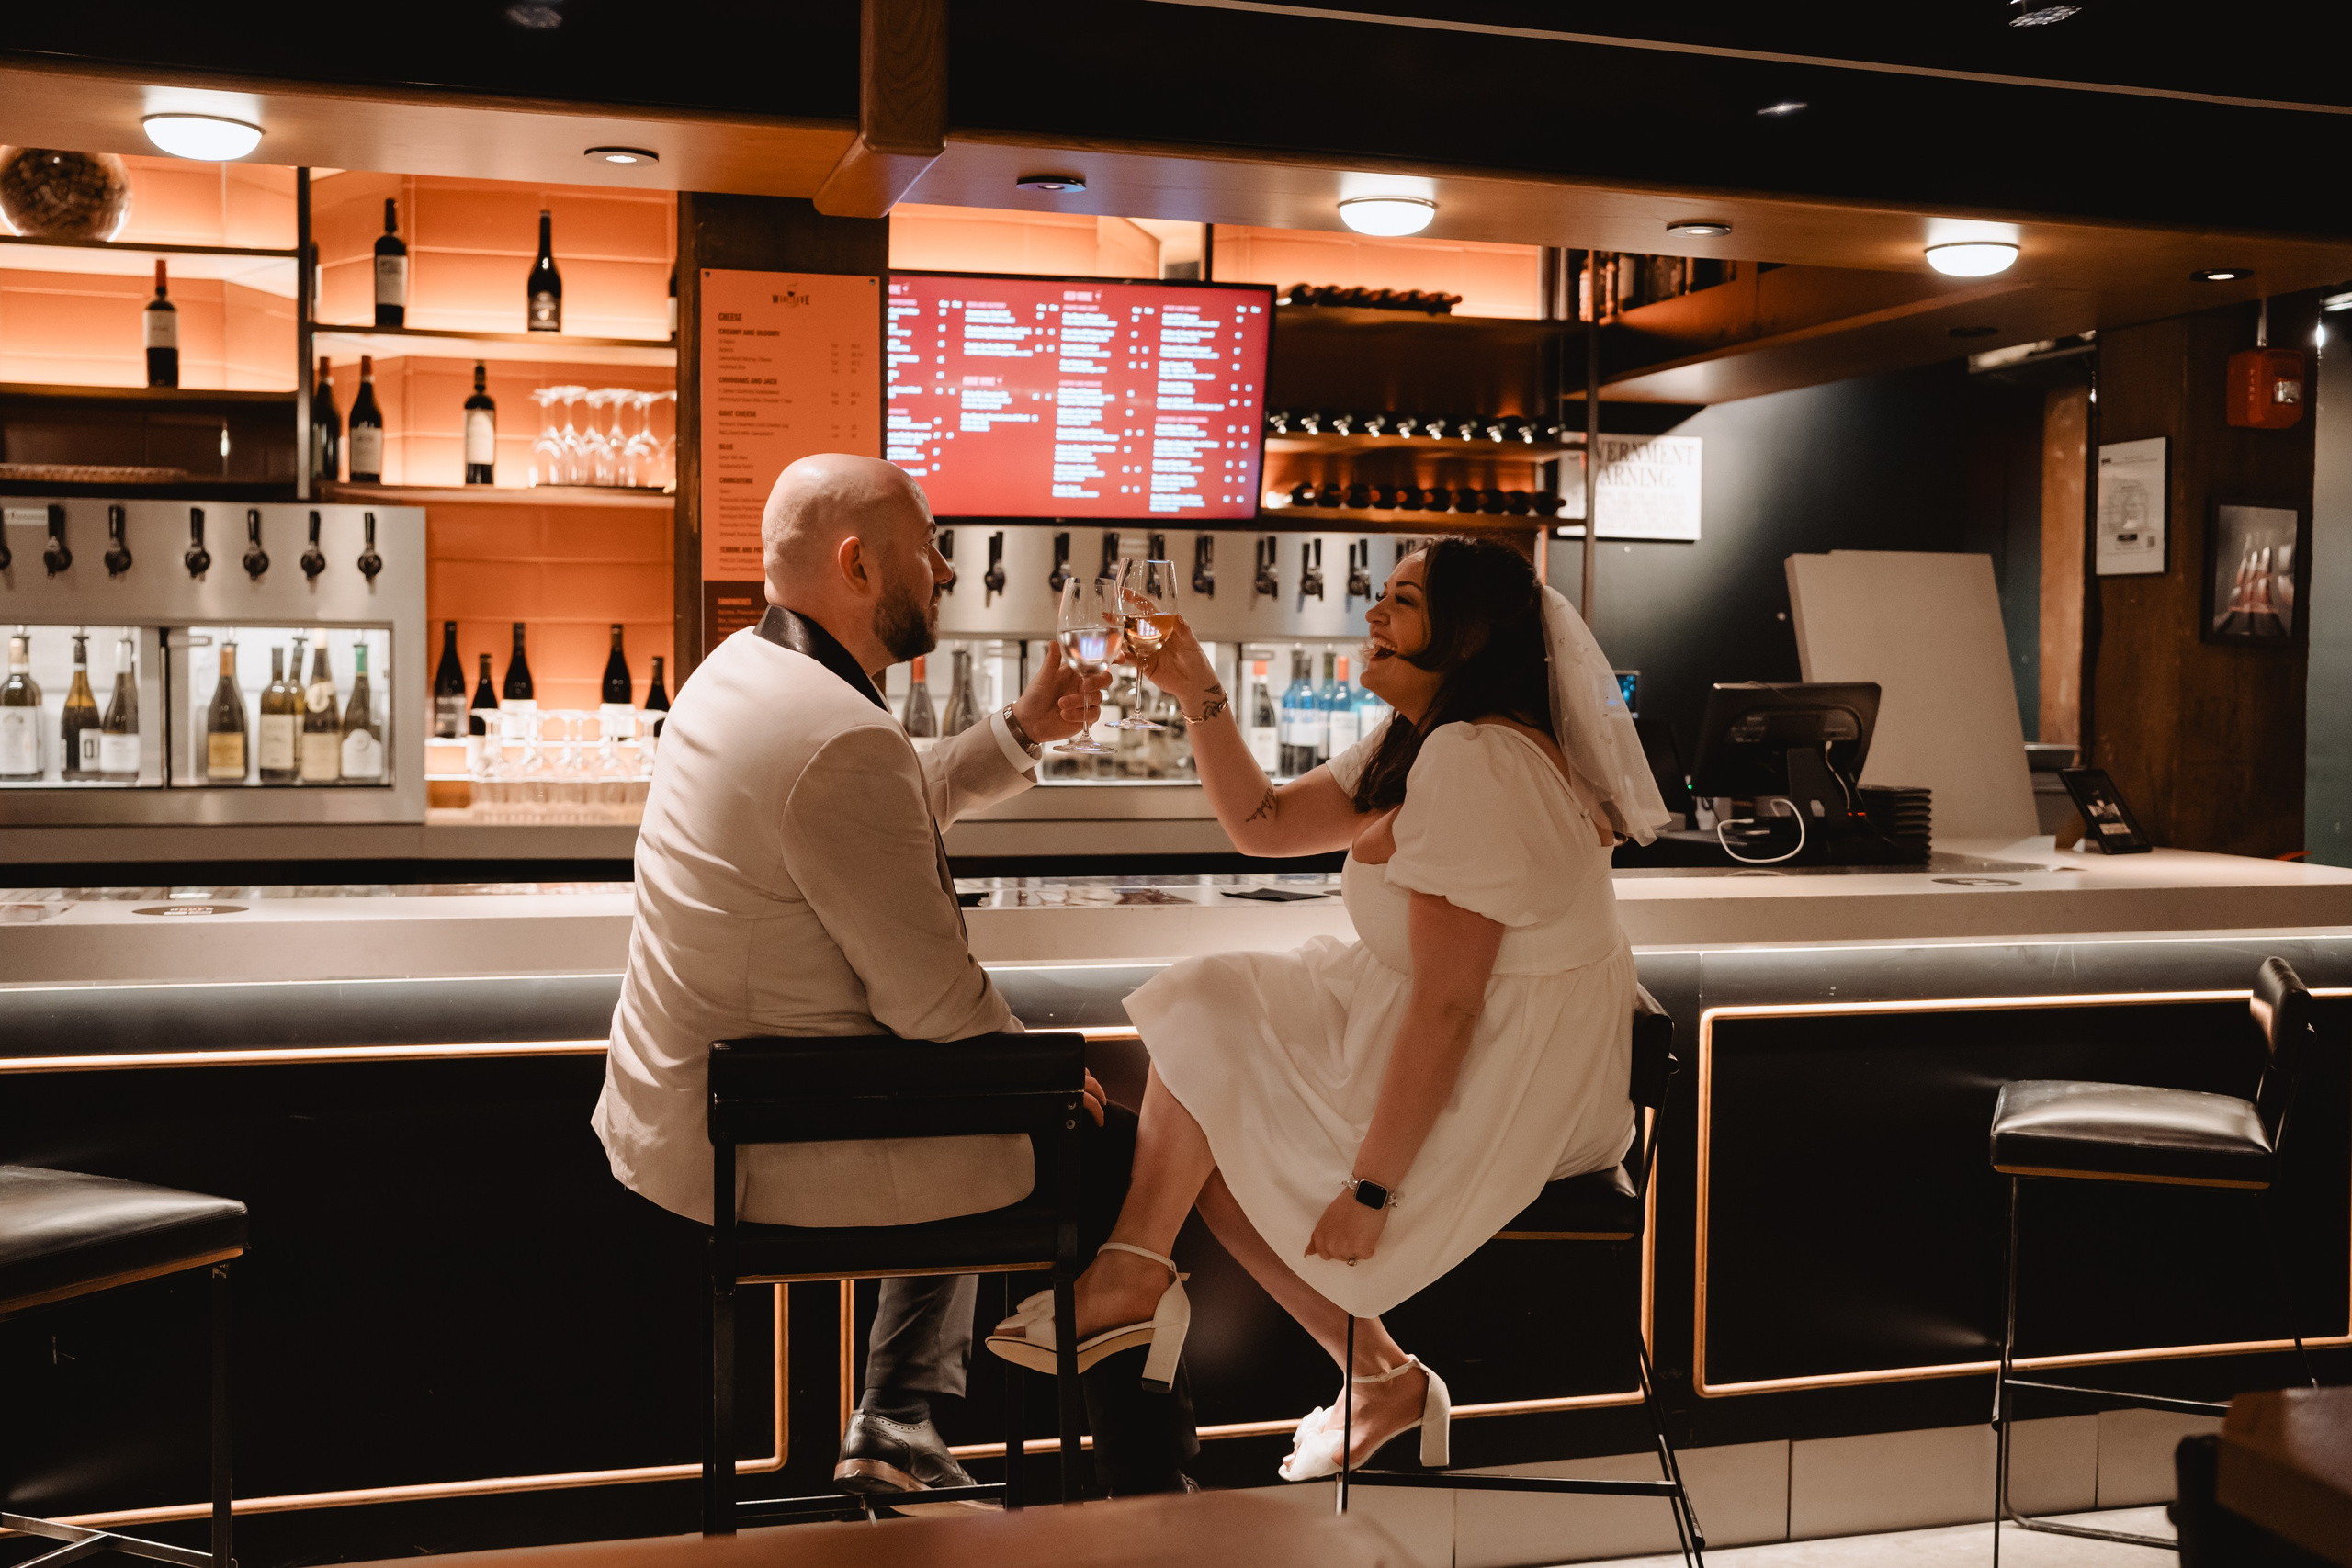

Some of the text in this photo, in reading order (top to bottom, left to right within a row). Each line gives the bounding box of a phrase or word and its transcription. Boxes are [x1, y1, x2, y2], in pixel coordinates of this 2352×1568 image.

[718, 313, 741, 321] CHEESE
[718, 443, 734, 451] BLUE
[1595, 441, 1695, 466] VERNMENT
[1599, 464, 1678, 489] ARNING:
